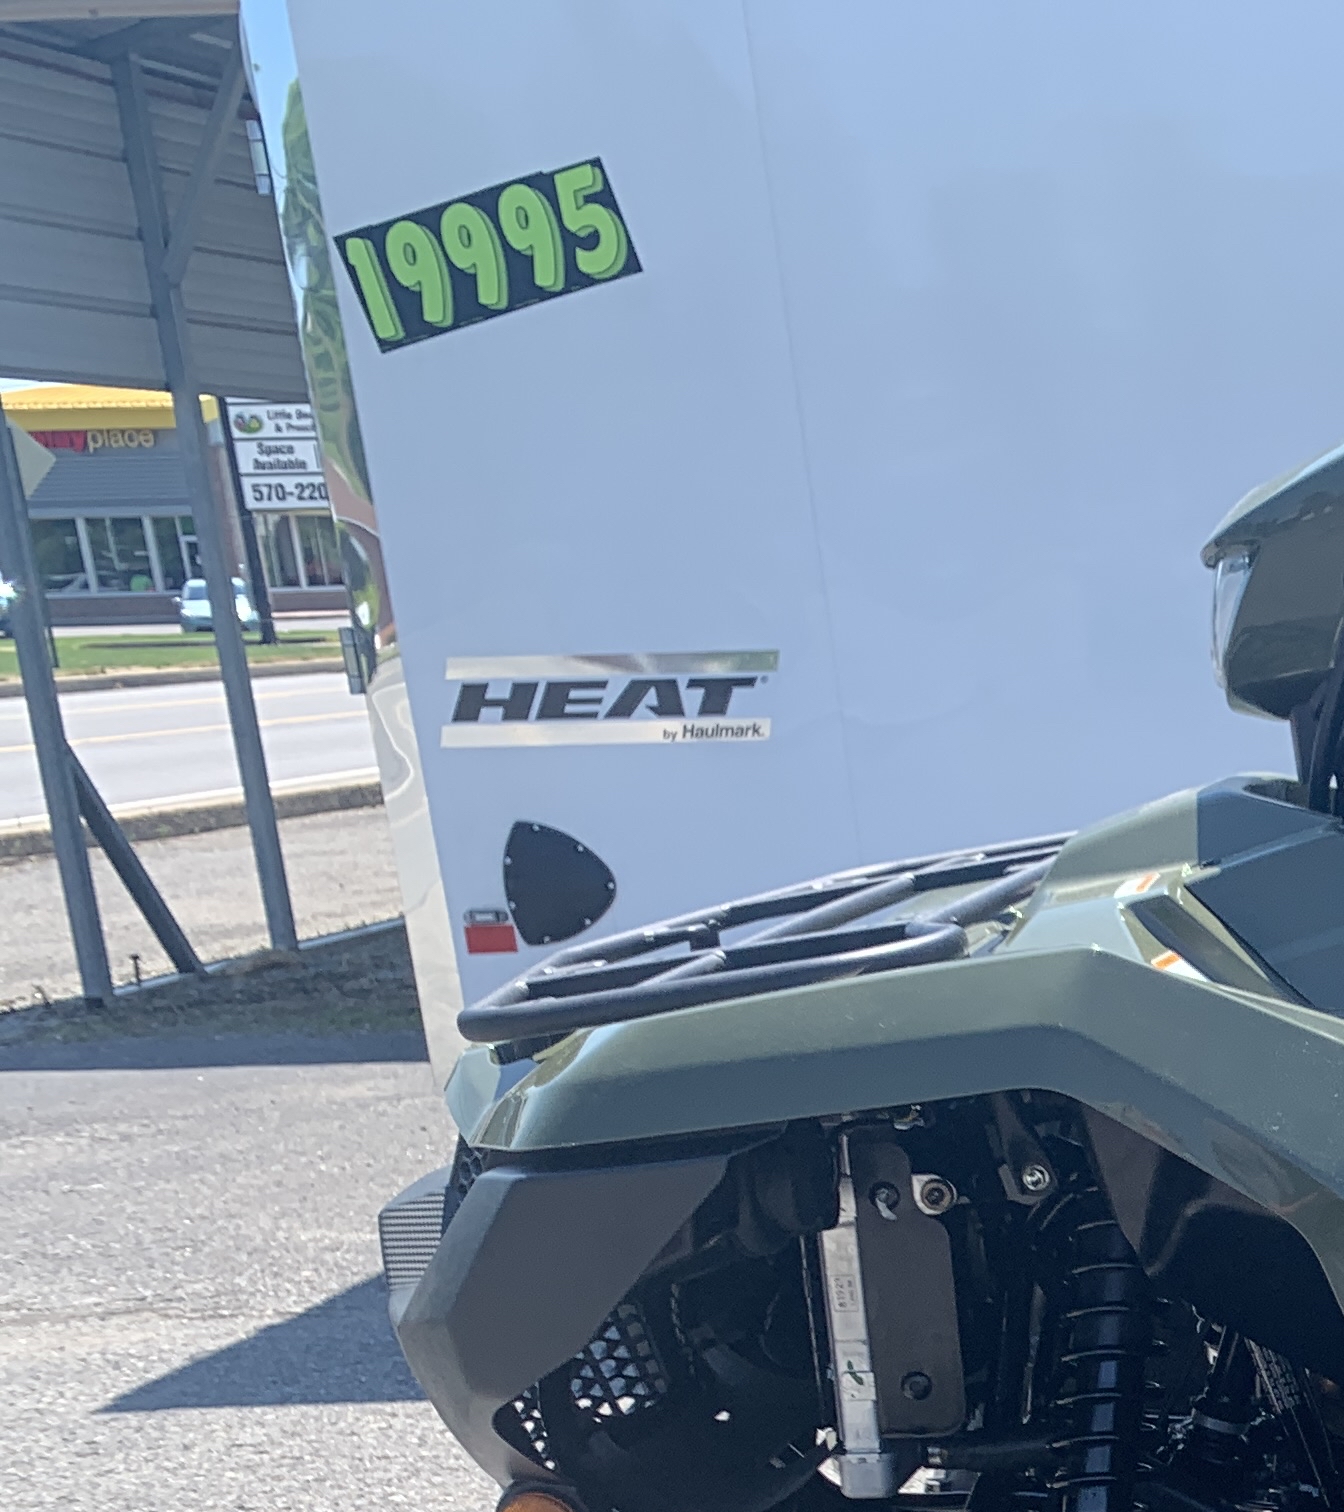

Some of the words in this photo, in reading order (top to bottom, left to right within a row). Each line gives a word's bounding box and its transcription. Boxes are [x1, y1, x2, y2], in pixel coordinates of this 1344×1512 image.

[346, 164, 628, 341] 19995
[87, 429, 155, 454] place
[256, 441, 294, 457] Space
[253, 458, 307, 470] Available
[452, 676, 758, 722] HEAT
[663, 728, 678, 742] by
[682, 723, 762, 740] Haulmark
